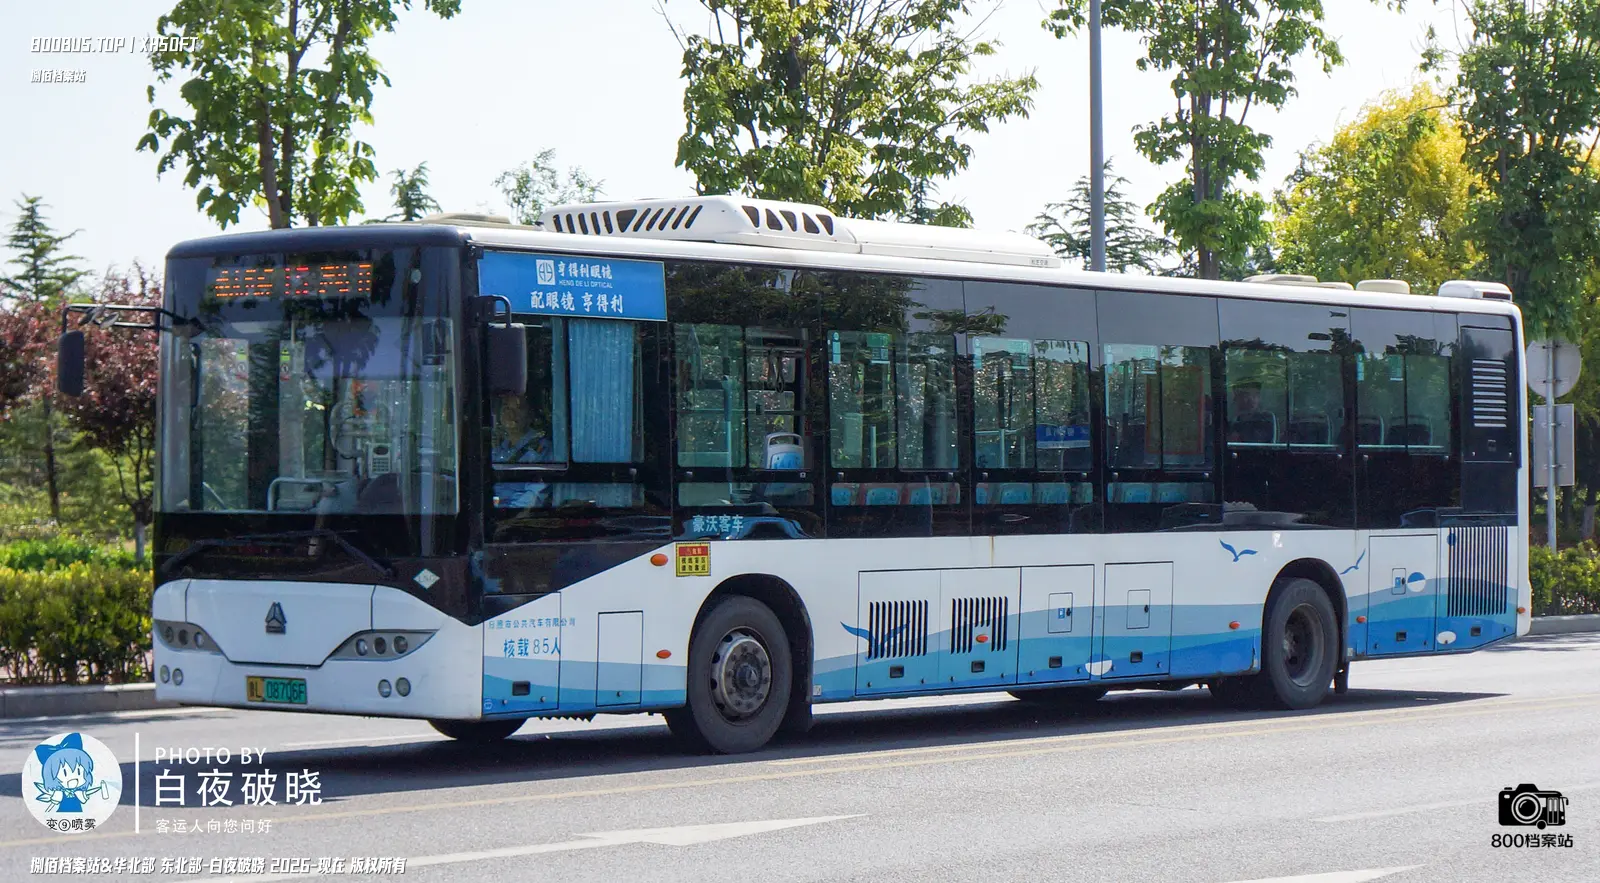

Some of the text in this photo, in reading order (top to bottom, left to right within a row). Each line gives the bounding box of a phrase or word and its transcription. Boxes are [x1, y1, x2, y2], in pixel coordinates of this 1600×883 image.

[531, 290, 576, 311] 配眼镜
[692, 514, 744, 533] 豪沃客车
[503, 637, 561, 658] 核载85人
